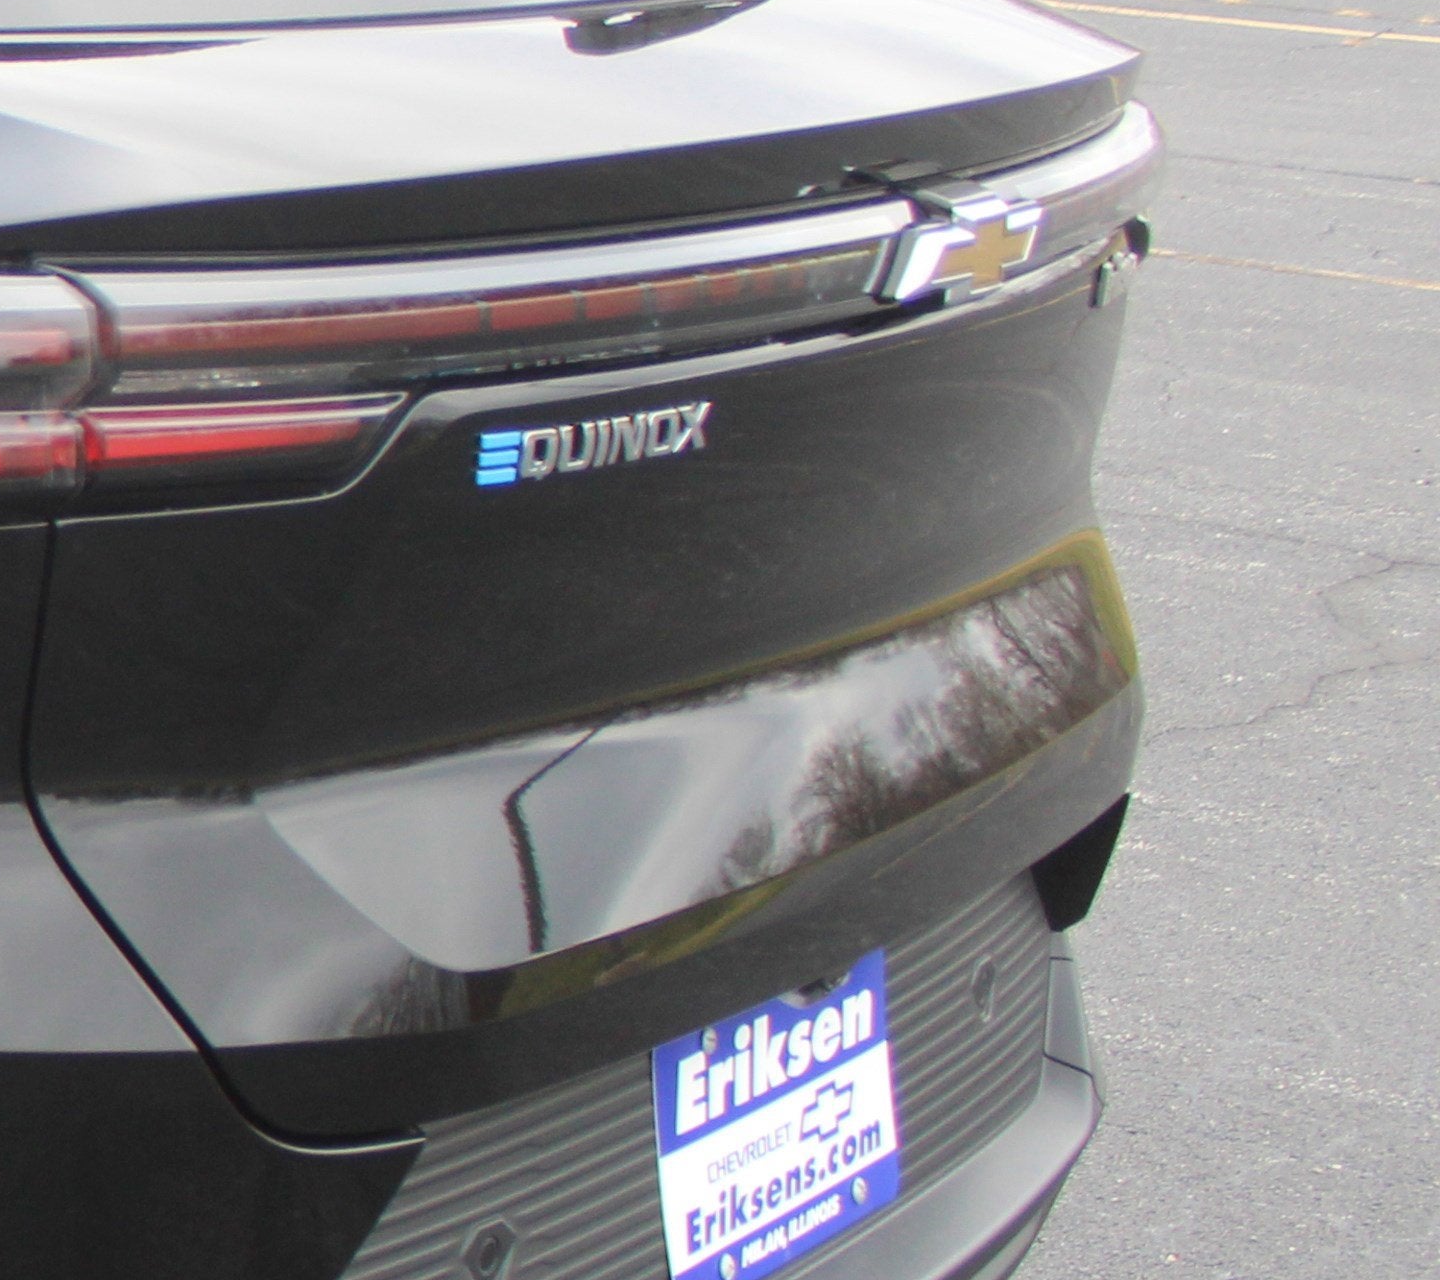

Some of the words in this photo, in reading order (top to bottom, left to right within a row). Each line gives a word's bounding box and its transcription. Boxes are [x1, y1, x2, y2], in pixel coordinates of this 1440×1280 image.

[475, 401, 714, 487] EQUINOX
[676, 988, 873, 1137] Eriksen
[687, 1120, 881, 1255] Eriksens.com
[707, 1122, 792, 1184] CHEVROLET
[787, 1193, 844, 1242] ILLINOIS
